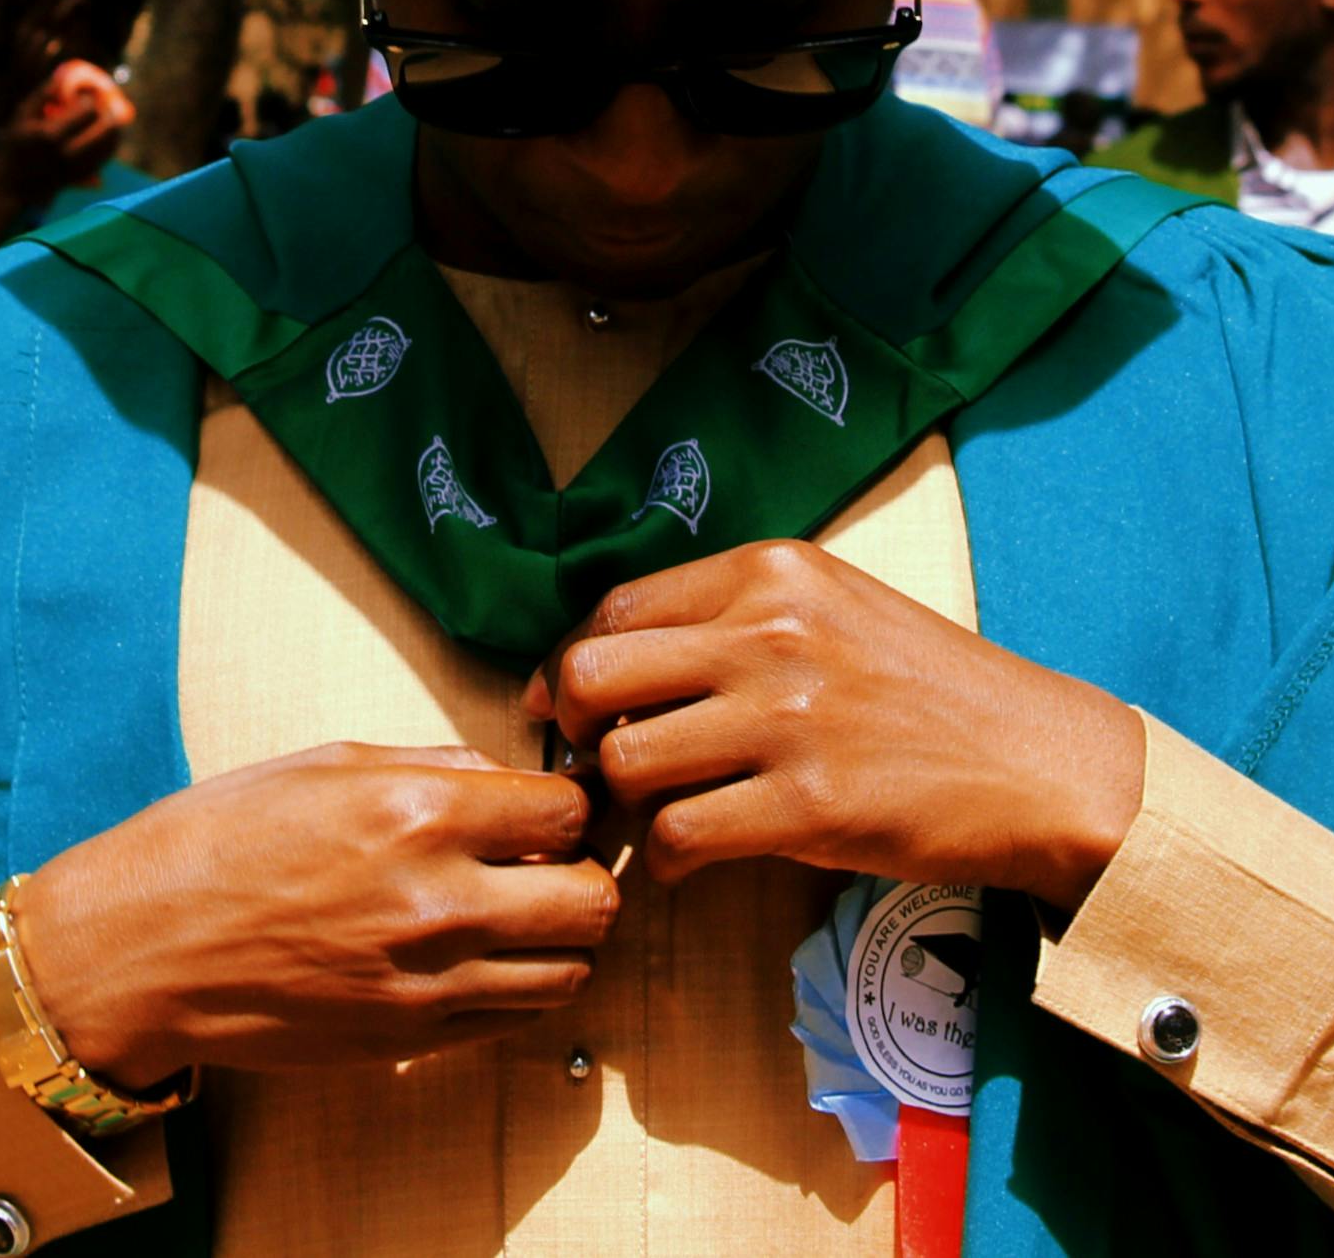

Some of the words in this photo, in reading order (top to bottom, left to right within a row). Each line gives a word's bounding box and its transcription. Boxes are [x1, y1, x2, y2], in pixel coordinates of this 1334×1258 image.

[863, 950, 880, 989] YOU
[875, 917, 900, 951] ARE
[898, 885, 976, 919] WELCOME
[867, 1015, 880, 1040] GOD
[875, 1040, 899, 1069] BLESS
[898, 1067, 916, 1084] YOU
[916, 1078, 928, 1091] AS
[928, 1084, 948, 1097] YOU
[949, 1086, 963, 1097] GO
[887, 1001, 896, 1023] I
[900, 1011, 938, 1036] was
[943, 1021, 978, 1049] the
